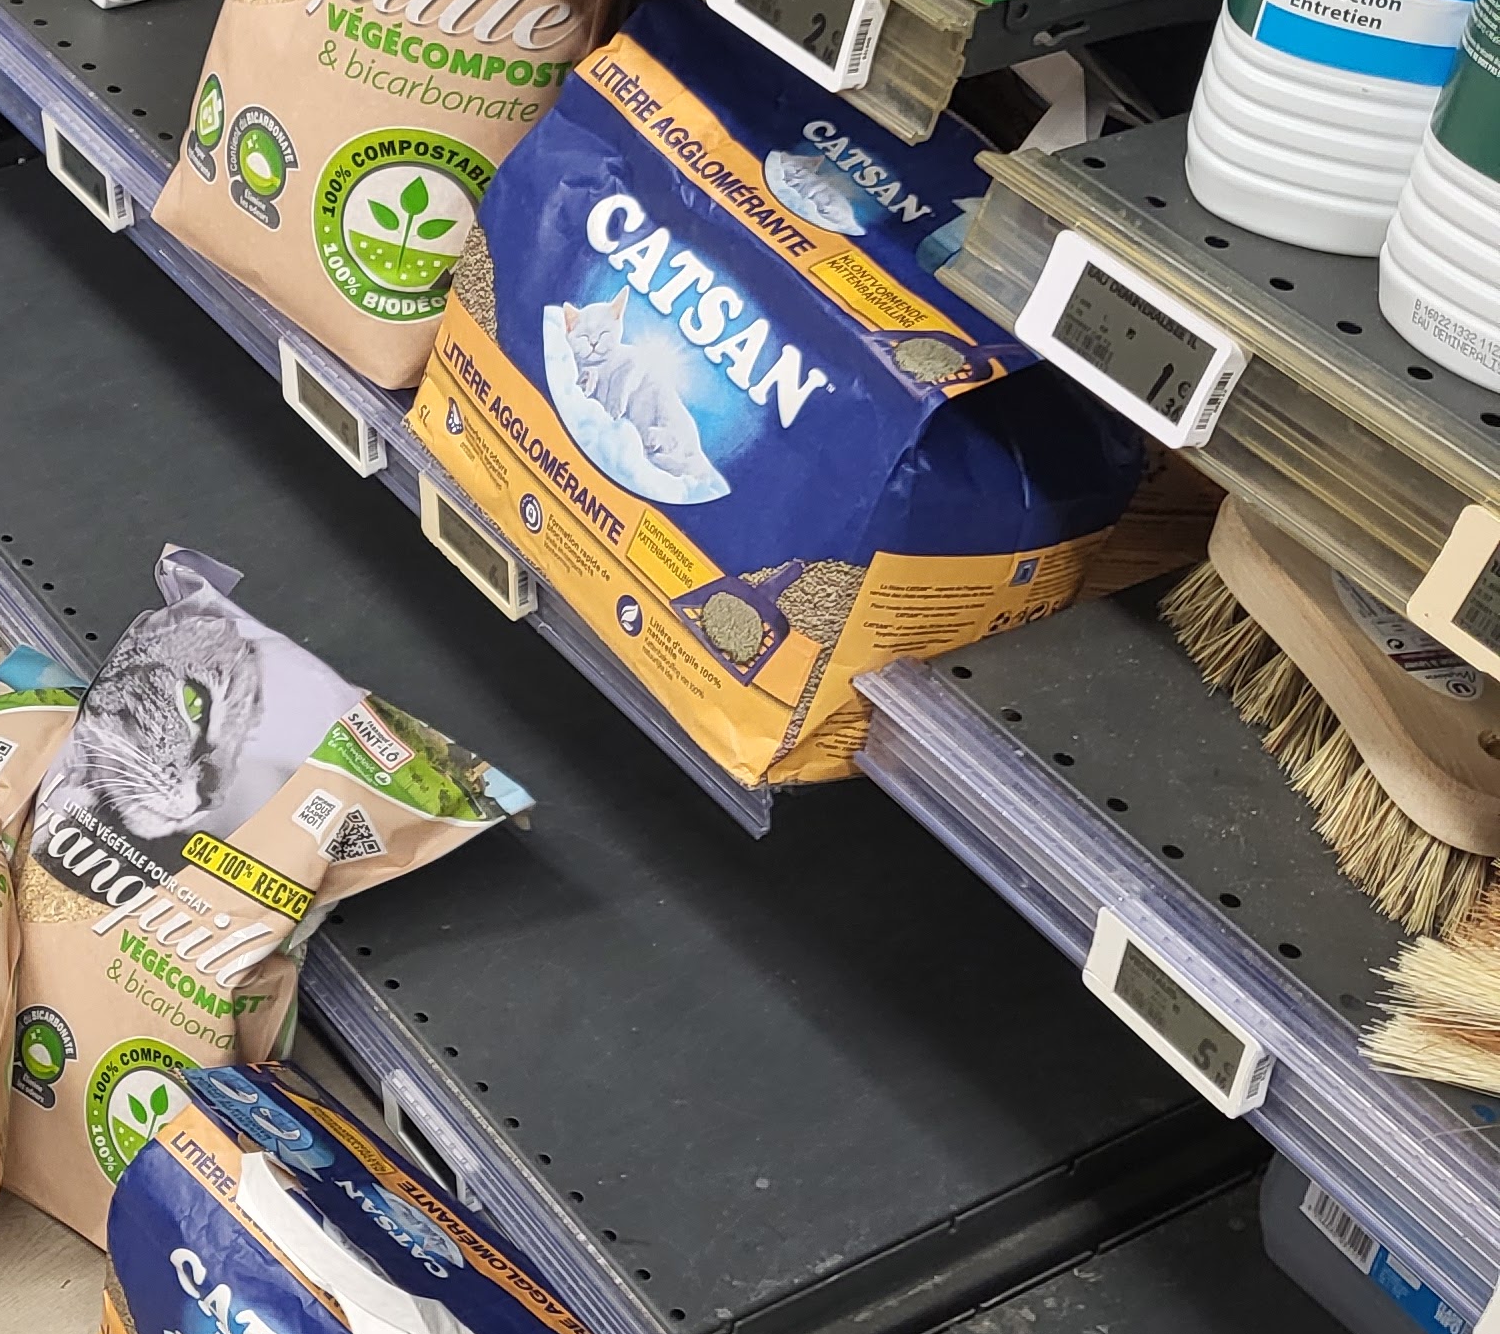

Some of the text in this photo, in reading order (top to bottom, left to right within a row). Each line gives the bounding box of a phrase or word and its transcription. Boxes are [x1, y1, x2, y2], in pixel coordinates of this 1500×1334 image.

[802, 12, 827, 53] 2
[316, 39, 540, 124] & bicarbonate
[246, 110, 294, 163] BICARBONATE
[589, 54, 818, 259] LITIÈRE AGGLOMÉRANTE
[321, 136, 495, 219] 100% COMPOSTABL
[802, 120, 932, 225] CATSAN
[323, 240, 361, 298] 100%
[825, 257, 918, 330] KATTENBAKVULLING
[838, 251, 929, 324] KLONTVORMENDE
[586, 193, 828, 429] CATSAN
[1411, 311, 1430, 331] EAU
[1423, 305, 1451, 330] 16022
[1452, 323, 1478, 346] 1332
[1146, 362, 1175, 405] 1
[441, 333, 626, 546] LITIÈRE AGGLOMÉRANTE
[549, 513, 579, 552] Formation
[577, 540, 602, 574] rapide
[637, 530, 694, 590] KATTENBAKVULLING
[642, 517, 695, 574] KLONTVORMENDE
[649, 615, 722, 691] Litière d'argile 100%
[331, 726, 350, 744] 47
[347, 712, 401, 764] SAINT-LÔ
[310, 799, 334, 818] VOUS
[33, 773, 283, 989] Tranquill
[63, 800, 212, 916] LITIÈRE VÉGÉTALE POUR CHAT
[187, 835, 313, 917] SAC 100% RECYC
[106, 958, 237, 1051] & bicarbona
[119, 928, 268, 1020] VÉGÉCOMPST
[31, 1009, 74, 1056] BICARBONATE
[92, 1060, 120, 1106] 100%
[91, 1123, 119, 1172] 100%
[170, 1130, 237, 1199] LITIÈRE
[334, 1179, 449, 1279] CATSAN
[397, 1180, 565, 1316] AGGLOMÉRANTE
